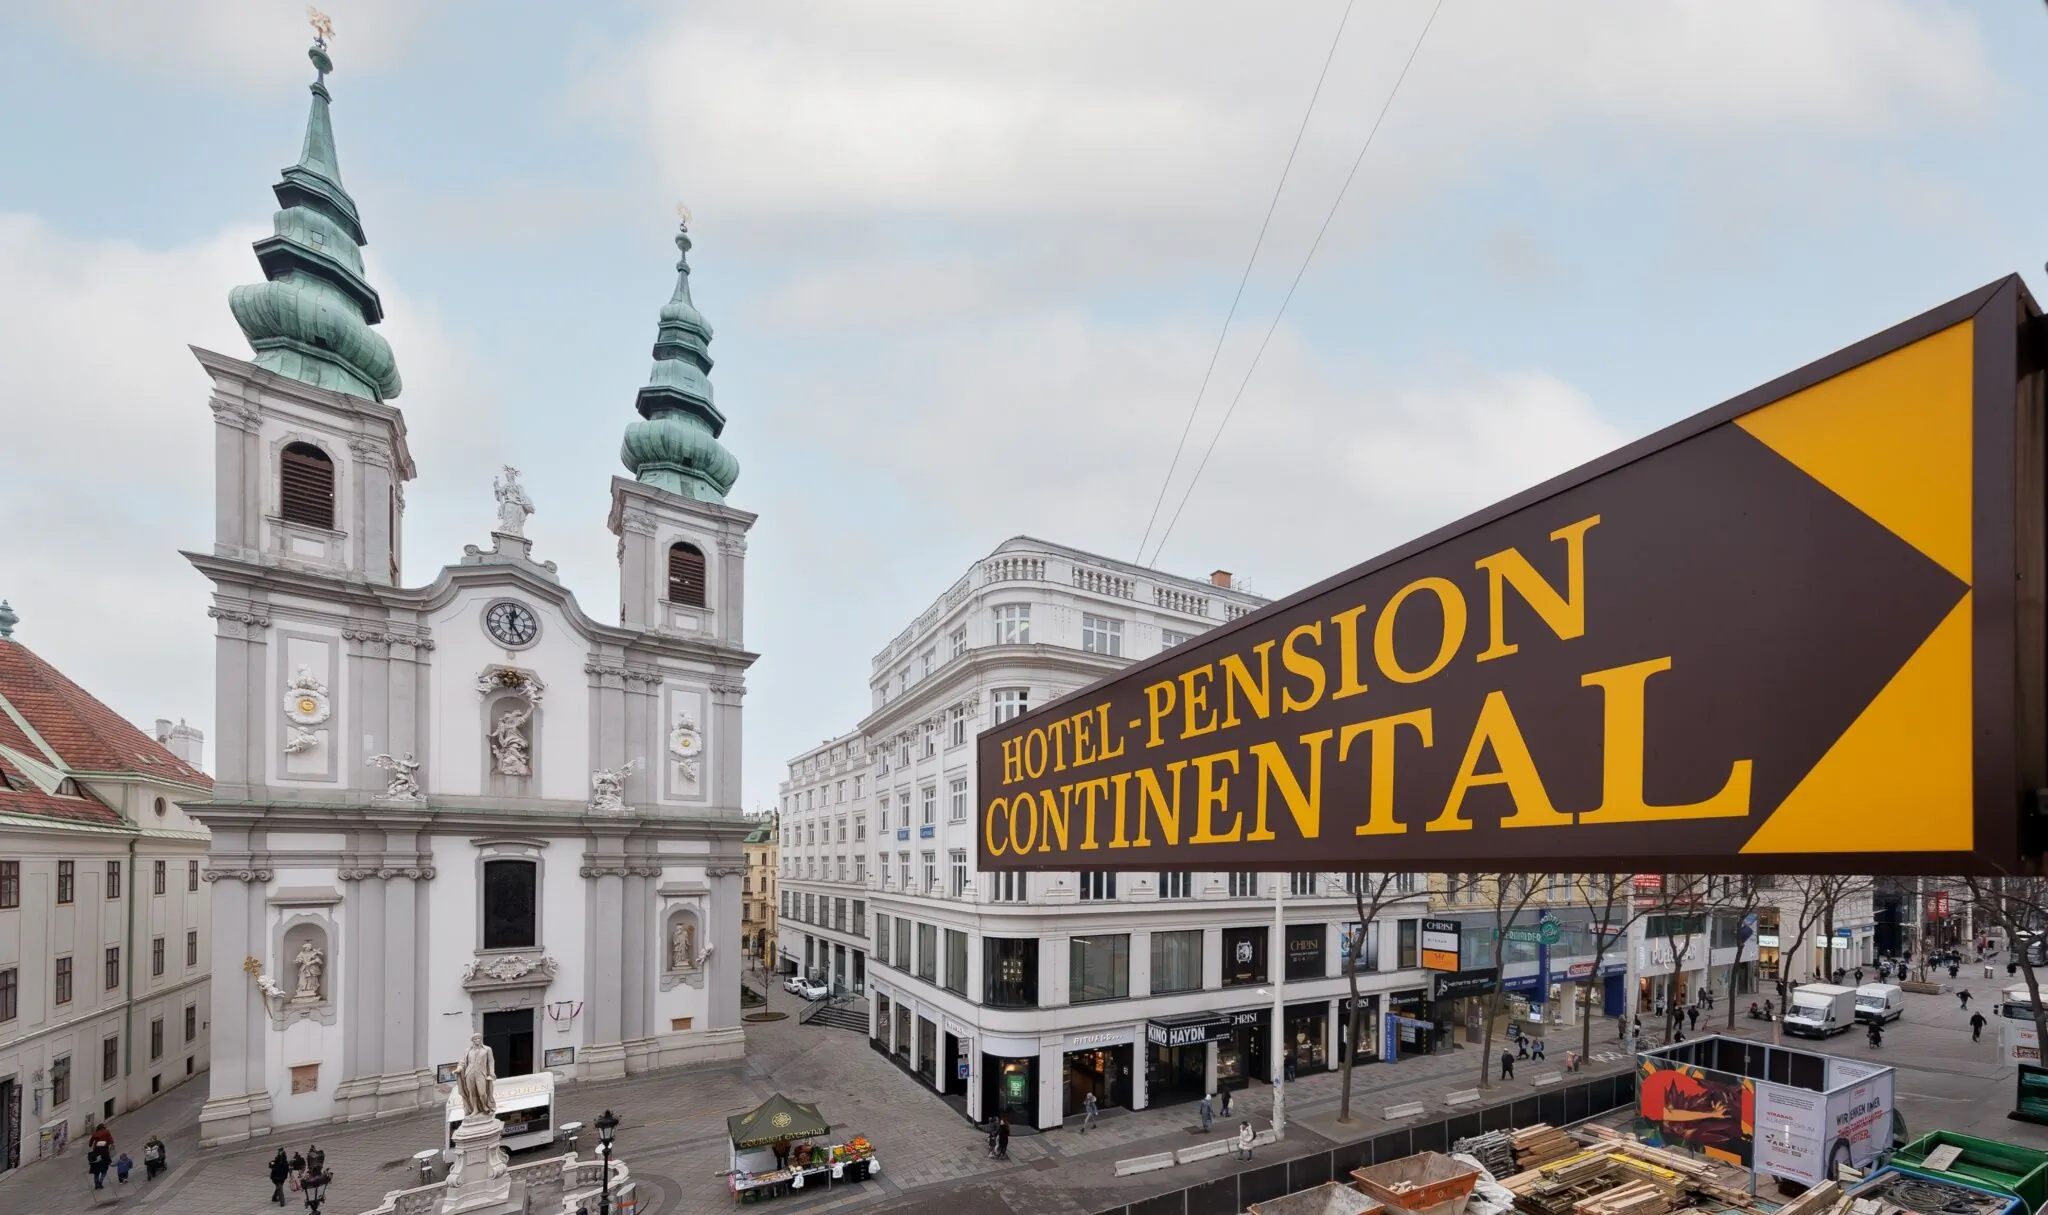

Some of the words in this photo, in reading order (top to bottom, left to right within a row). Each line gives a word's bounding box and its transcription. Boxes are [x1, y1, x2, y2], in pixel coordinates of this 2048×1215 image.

[1002, 514, 1600, 785] HOTEL-PENSION
[985, 656, 1752, 856] CONTINENTAL
[1426, 921, 1454, 931] CHRIST
[1290, 939, 1318, 951] CHRIST
[1345, 997, 1370, 1010] CRIST
[1148, 1025, 1167, 1044] KINO
[1169, 1026, 1205, 1044] HAYDN
[1836, 1112, 1849, 1126] WIR
